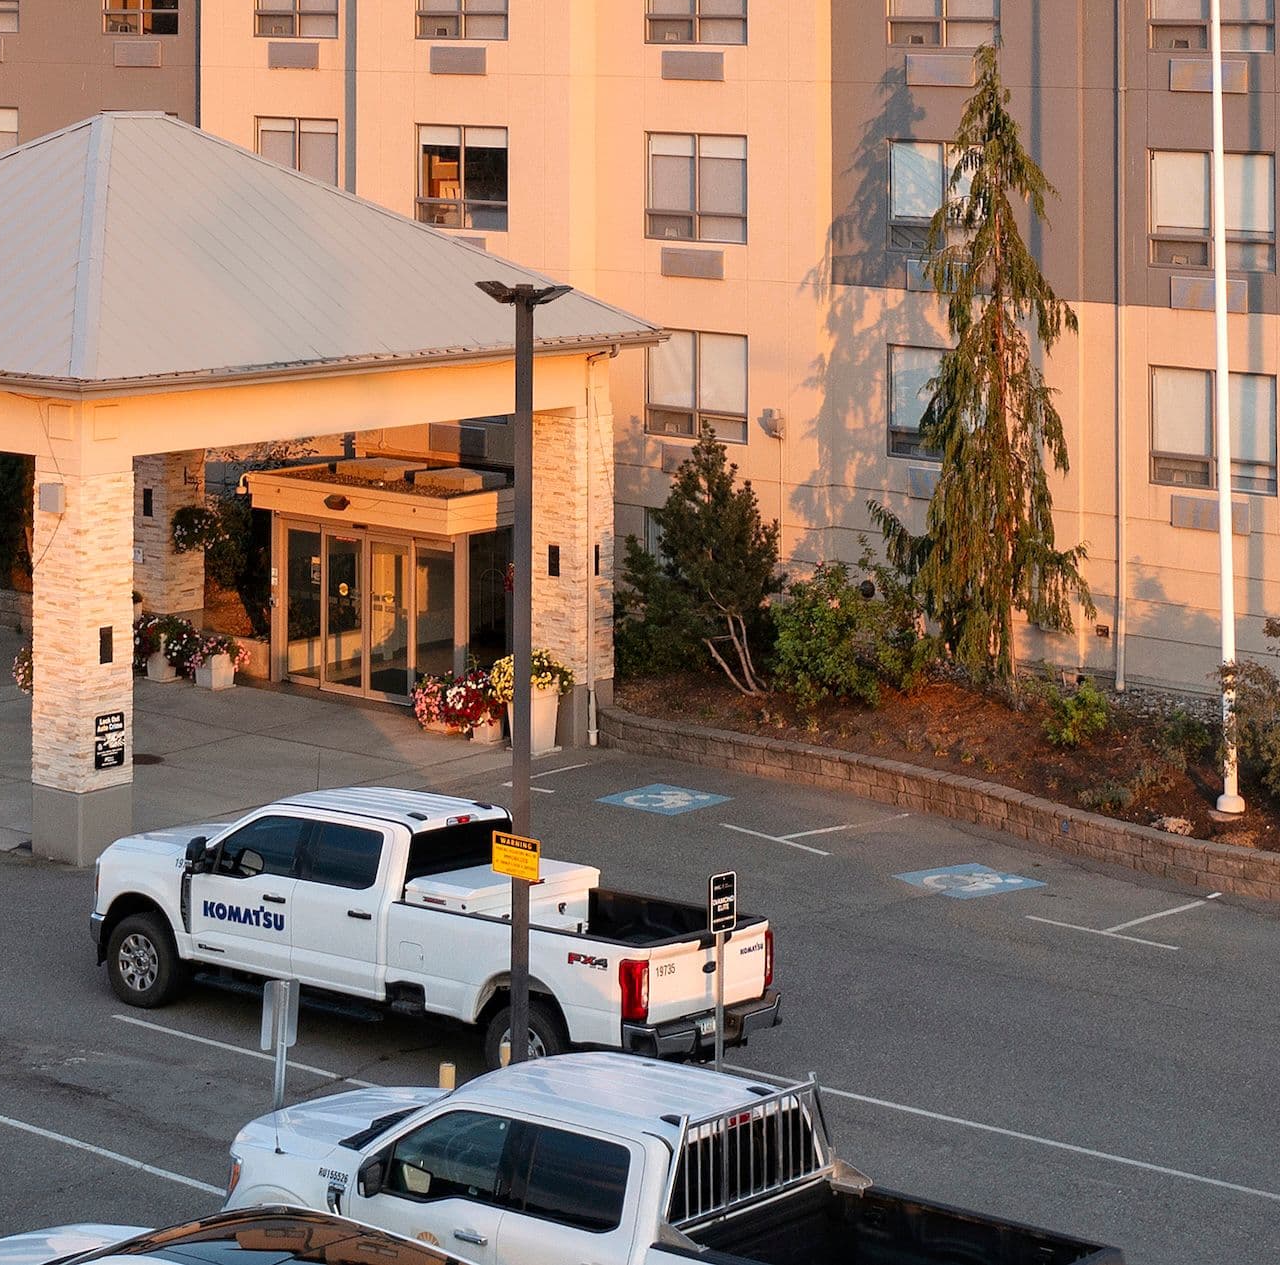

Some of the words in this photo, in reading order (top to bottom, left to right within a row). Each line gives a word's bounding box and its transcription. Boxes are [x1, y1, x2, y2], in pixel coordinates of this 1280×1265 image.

[500, 836, 533, 850] WARNING
[712, 894, 734, 906] DIAMOND
[203, 900, 285, 931] KOMATSU
[740, 942, 764, 955] KOMATSU
[567, 951, 608, 968] FX4
[655, 962, 676, 977] 19735
